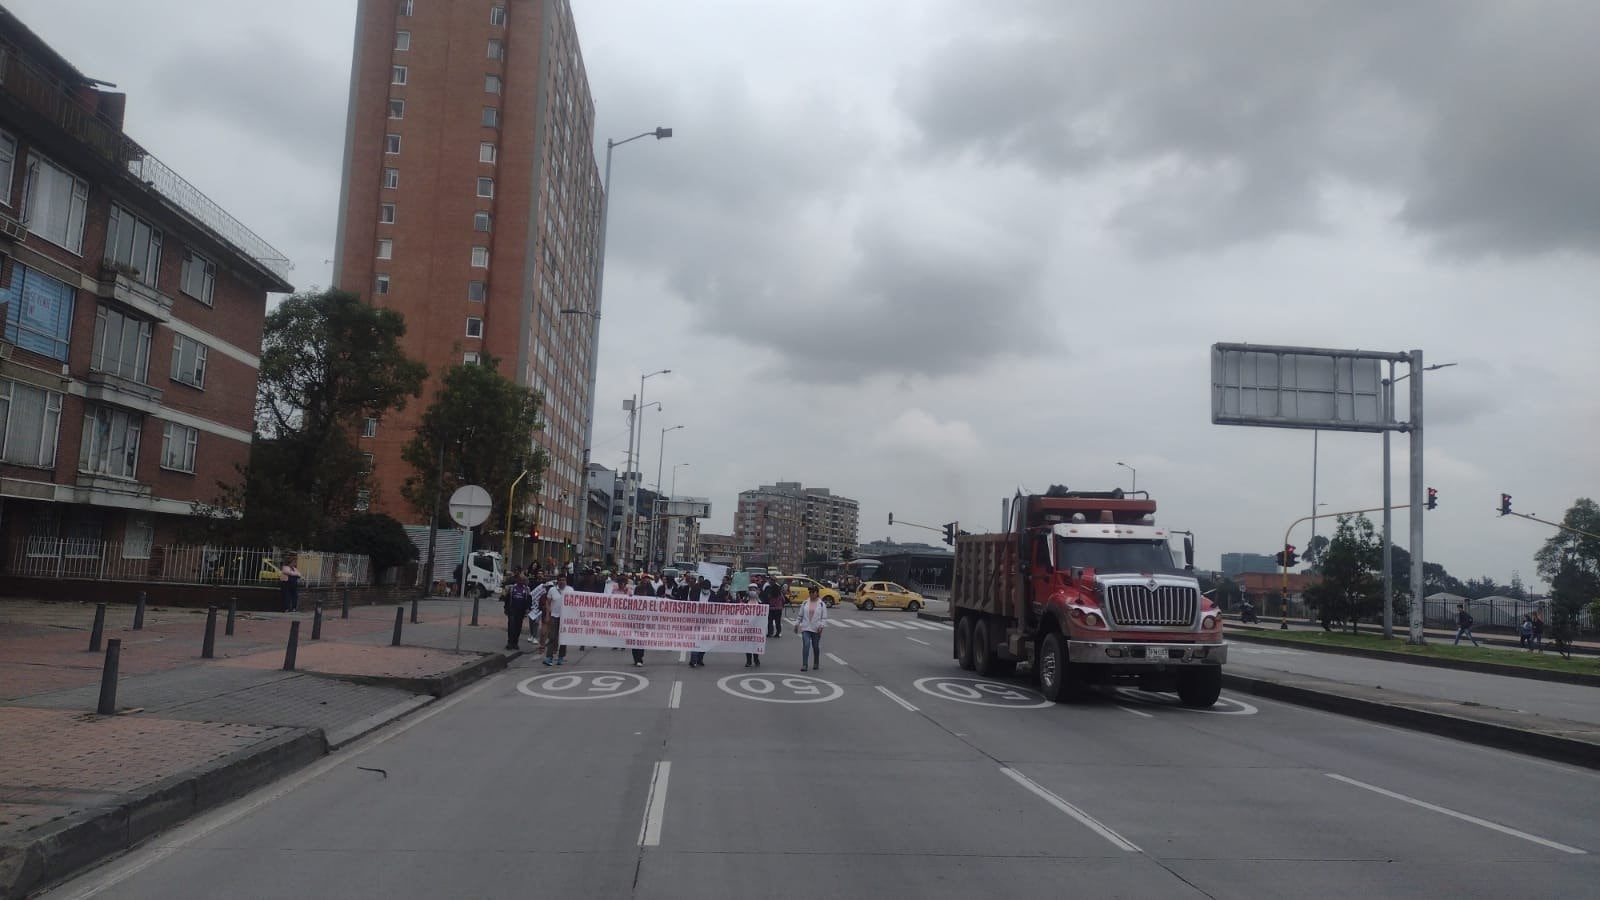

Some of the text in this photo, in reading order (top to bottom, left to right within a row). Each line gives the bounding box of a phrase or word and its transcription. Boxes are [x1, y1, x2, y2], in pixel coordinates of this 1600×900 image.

[564, 594, 612, 609] GACHANCIPA
[613, 597, 647, 611] RECHAZA
[649, 599, 658, 612] EL
[659, 600, 697, 615] CATASTRO
[628, 613, 646, 621] ESTADO
[541, 675, 627, 691] 50
[739, 677, 820, 695] 50
[936, 682, 1031, 700] 50
